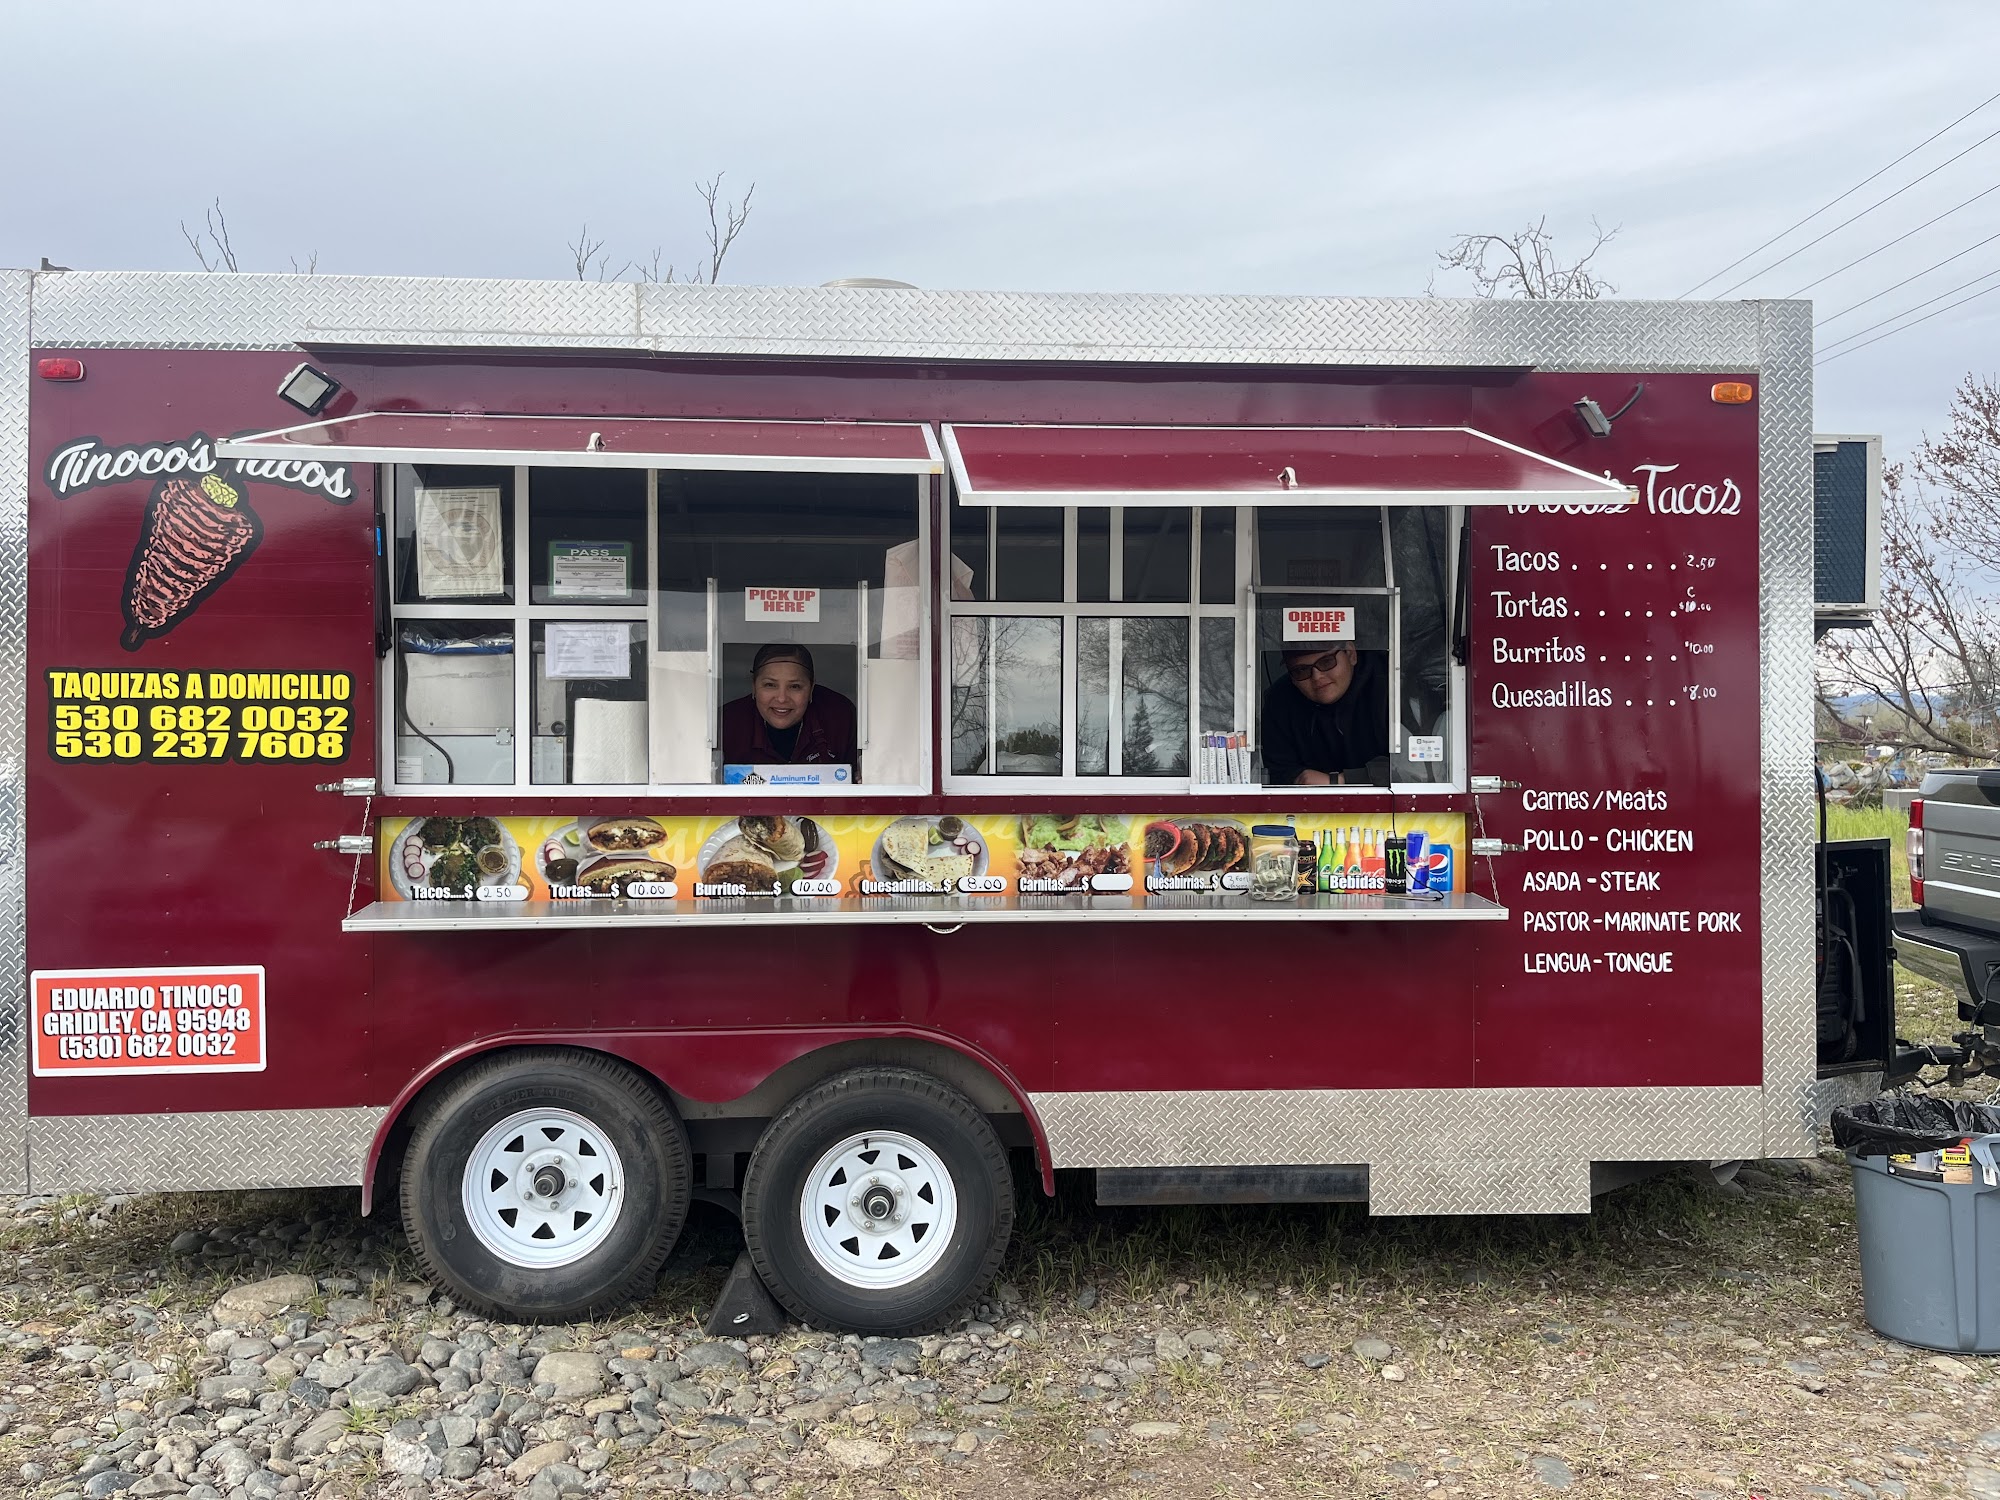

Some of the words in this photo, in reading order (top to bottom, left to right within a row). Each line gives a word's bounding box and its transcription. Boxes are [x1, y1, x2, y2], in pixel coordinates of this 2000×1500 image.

[50, 438, 217, 494] Tinoco's
[1632, 463, 1742, 516] Tacos
[570, 549, 610, 557] PASS
[1490, 544, 1560, 572] Tacos
[749, 589, 790, 601] PICK
[793, 590, 816, 602] UP
[763, 600, 805, 613] HERE
[1490, 591, 1568, 618] Tortas
[1288, 611, 1346, 622] ORDER
[1297, 622, 1340, 633] HERE
[1492, 636, 1586, 664] Burritos
[50, 672, 181, 702] TAQUIZAS
[185, 673, 204, 699] A
[209, 673, 350, 700] DOMICILIO
[1491, 680, 1613, 709] Quesadillas
[55, 705, 139, 731] 530
[150, 705, 231, 731] 682
[241, 706, 348, 731] 0032
[55, 732, 141, 758] 530
[152, 732, 230, 758] 237
[238, 732, 344, 758] 7608
[1523, 829, 1584, 851] POLLO
[1606, 828, 1694, 852] CHICKEN
[633, 884, 666, 896] 10.00
[799, 881, 833, 893] 10.00
[967, 878, 1003, 891] 8.00
[1330, 875, 1386, 890] Bebidas
[1523, 871, 1582, 892] ASADA
[1600, 870, 1661, 892] STEAK
[1697, 911, 1742, 932] PORK
[51, 986, 155, 1011] EDUARDO
[159, 984, 243, 1009] TINOCO
[43, 1011, 136, 1035] GRIDLEY,
[141, 1010, 172, 1033] CA
[176, 1008, 250, 1032] 95948
[59, 1036, 122, 1059] (530)
[127, 1035, 172, 1058] 682
[177, 1032, 236, 1056] 0032
